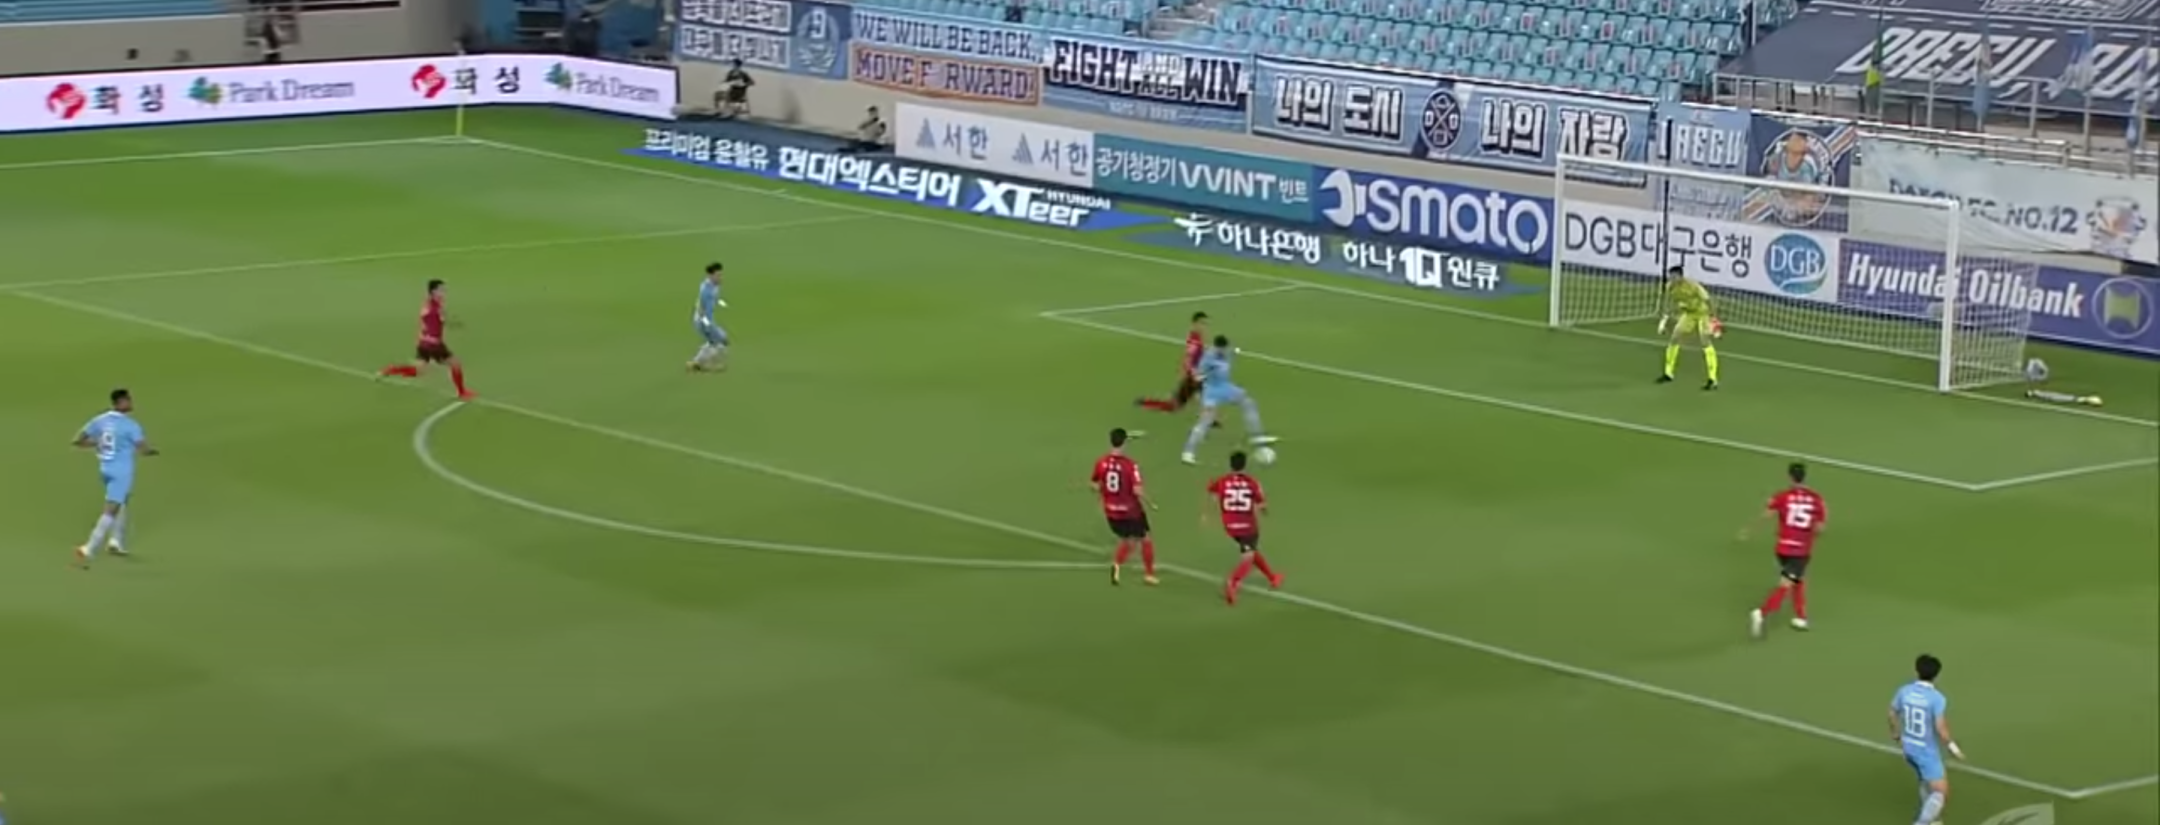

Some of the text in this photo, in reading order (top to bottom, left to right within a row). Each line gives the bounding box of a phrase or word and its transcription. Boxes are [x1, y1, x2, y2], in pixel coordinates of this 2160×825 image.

[855, 14, 888, 42] WE
[892, 18, 941, 49] WILL
[946, 24, 973, 53] BE
[855, 50, 914, 85] MOVE
[1050, 40, 1138, 93] FIGHT
[1181, 57, 1242, 105] WIN
[229, 78, 355, 103] Park Dream
[1275, 73, 1334, 131] 나의
[1343, 81, 1404, 138] 도시
[1482, 97, 1546, 158] 나의
[1558, 107, 1629, 163] 자랑
[943, 122, 988, 160] 서한
[1041, 138, 1090, 177] 서한
[779, 146, 961, 207] 현대엑스티어
[1096, 147, 1176, 187] 공기청정기
[971, 178, 1090, 227] XTeer
[1217, 221, 1321, 264] 하나은행
[1769, 243, 1821, 275] DGB
[1968, 267, 2084, 318] Oilbank
[1106, 470, 1120, 493] 8
[1223, 488, 1252, 512] 25
[1785, 502, 1814, 528] 15
[1903, 703, 1926, 738] 18
